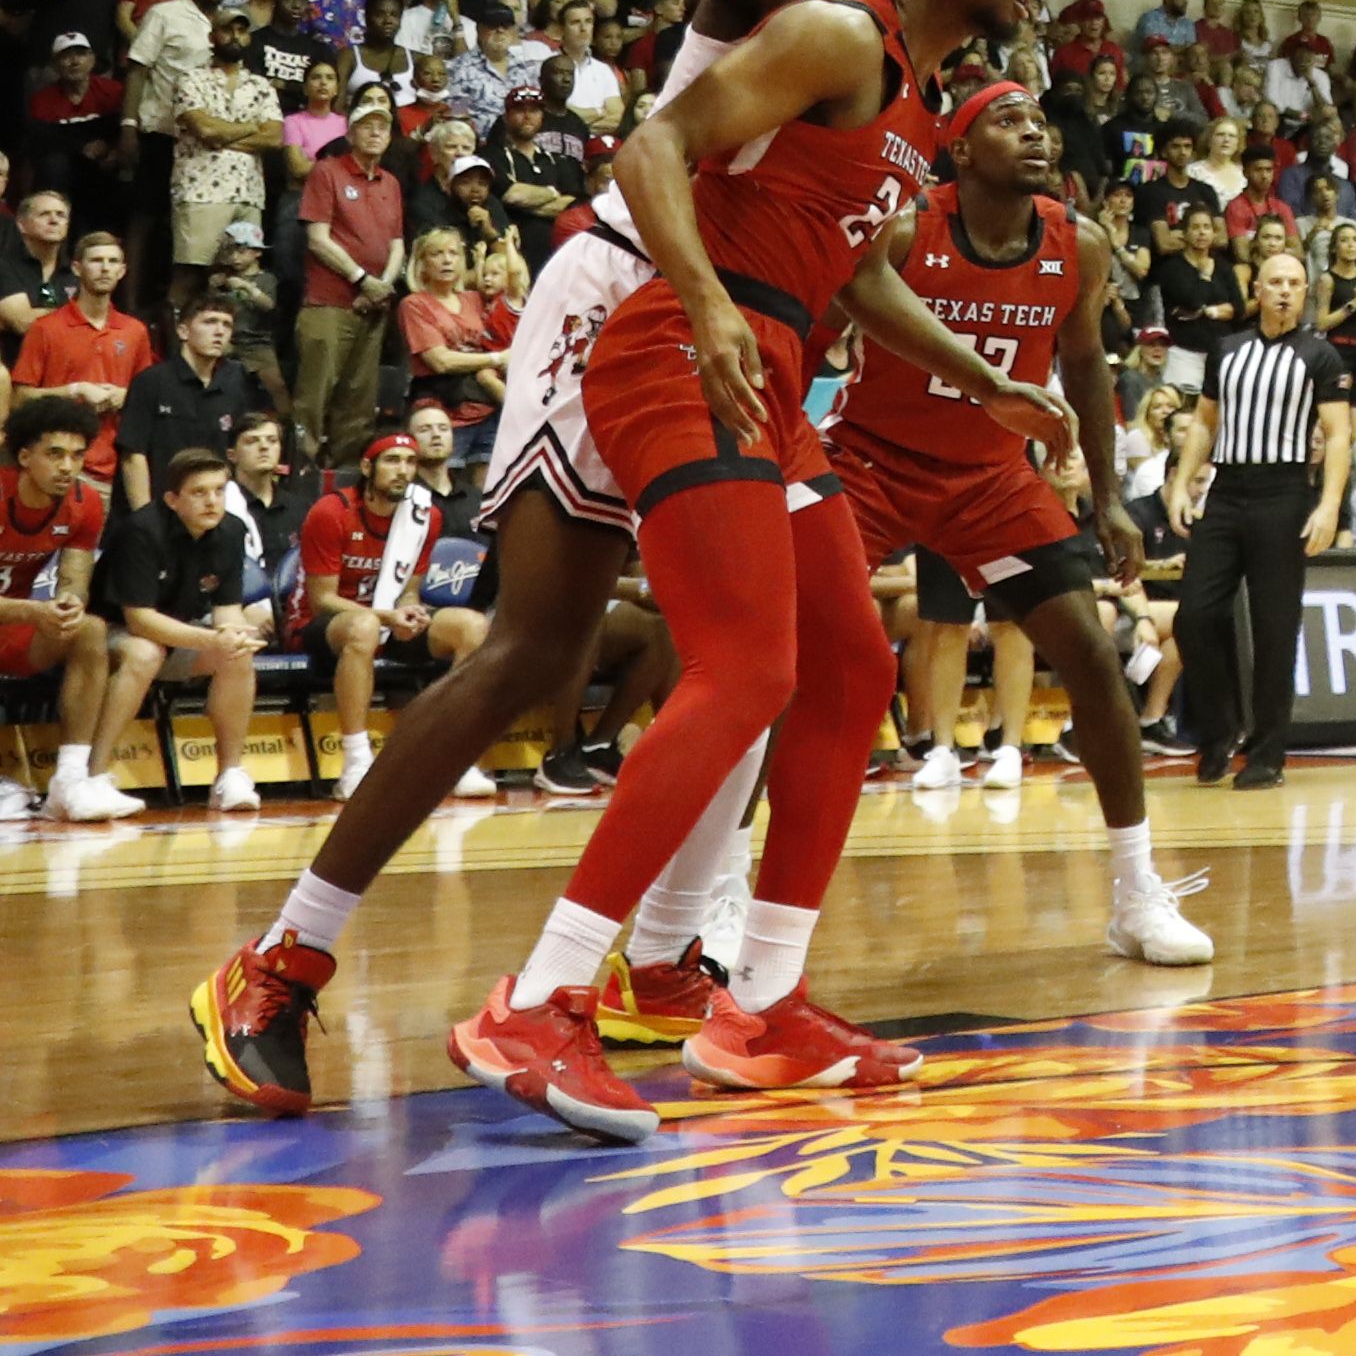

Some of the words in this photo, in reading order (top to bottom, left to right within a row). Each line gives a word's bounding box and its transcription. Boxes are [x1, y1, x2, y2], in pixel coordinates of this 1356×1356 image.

[881, 130, 918, 182] TEXAS
[838, 175, 902, 249] 2
[1001, 303, 1056, 327] TECH
[181, 737, 284, 762] Contental
